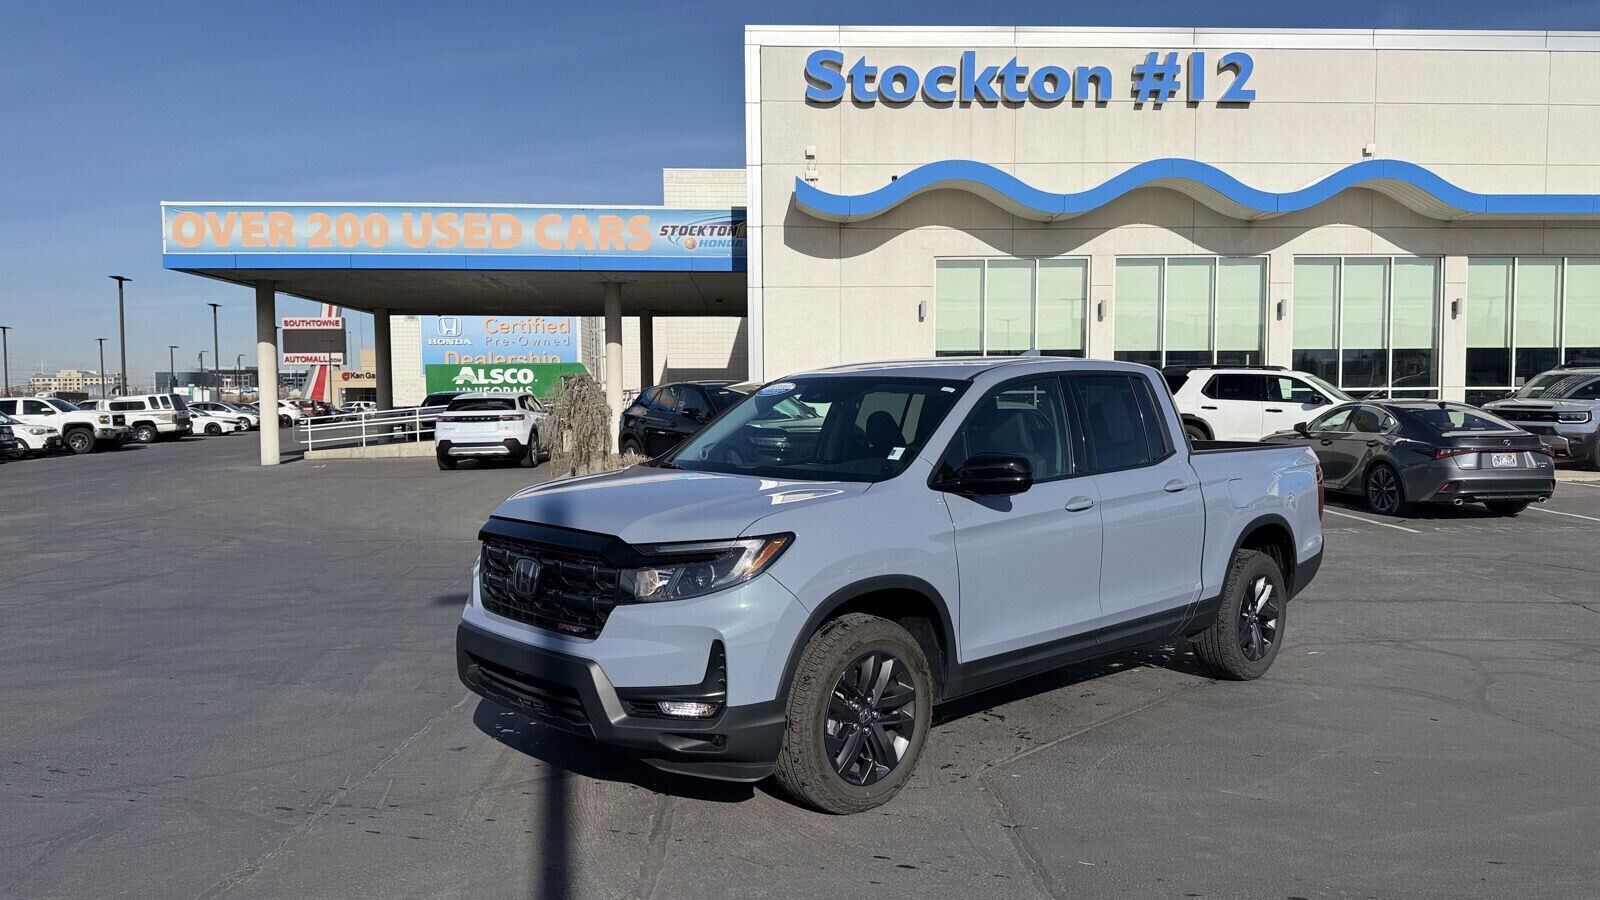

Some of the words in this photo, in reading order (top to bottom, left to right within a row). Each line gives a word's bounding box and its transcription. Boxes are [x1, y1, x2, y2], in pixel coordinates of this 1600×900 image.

[804, 50, 1113, 104] Stockton
[1131, 51, 1257, 105] #12
[171, 210, 297, 249] OVER
[307, 212, 390, 249] 200
[402, 212, 523, 249] USED
[534, 213, 653, 251] CARS
[698, 239, 743, 248] HONDA
[283, 319, 341, 327] SOUTHTOWNE
[482, 316, 571, 335] Certified
[428, 338, 473, 346] HONDA
[485, 336, 571, 347] Pre-Owned
[452, 366, 535, 385] ALSCO
